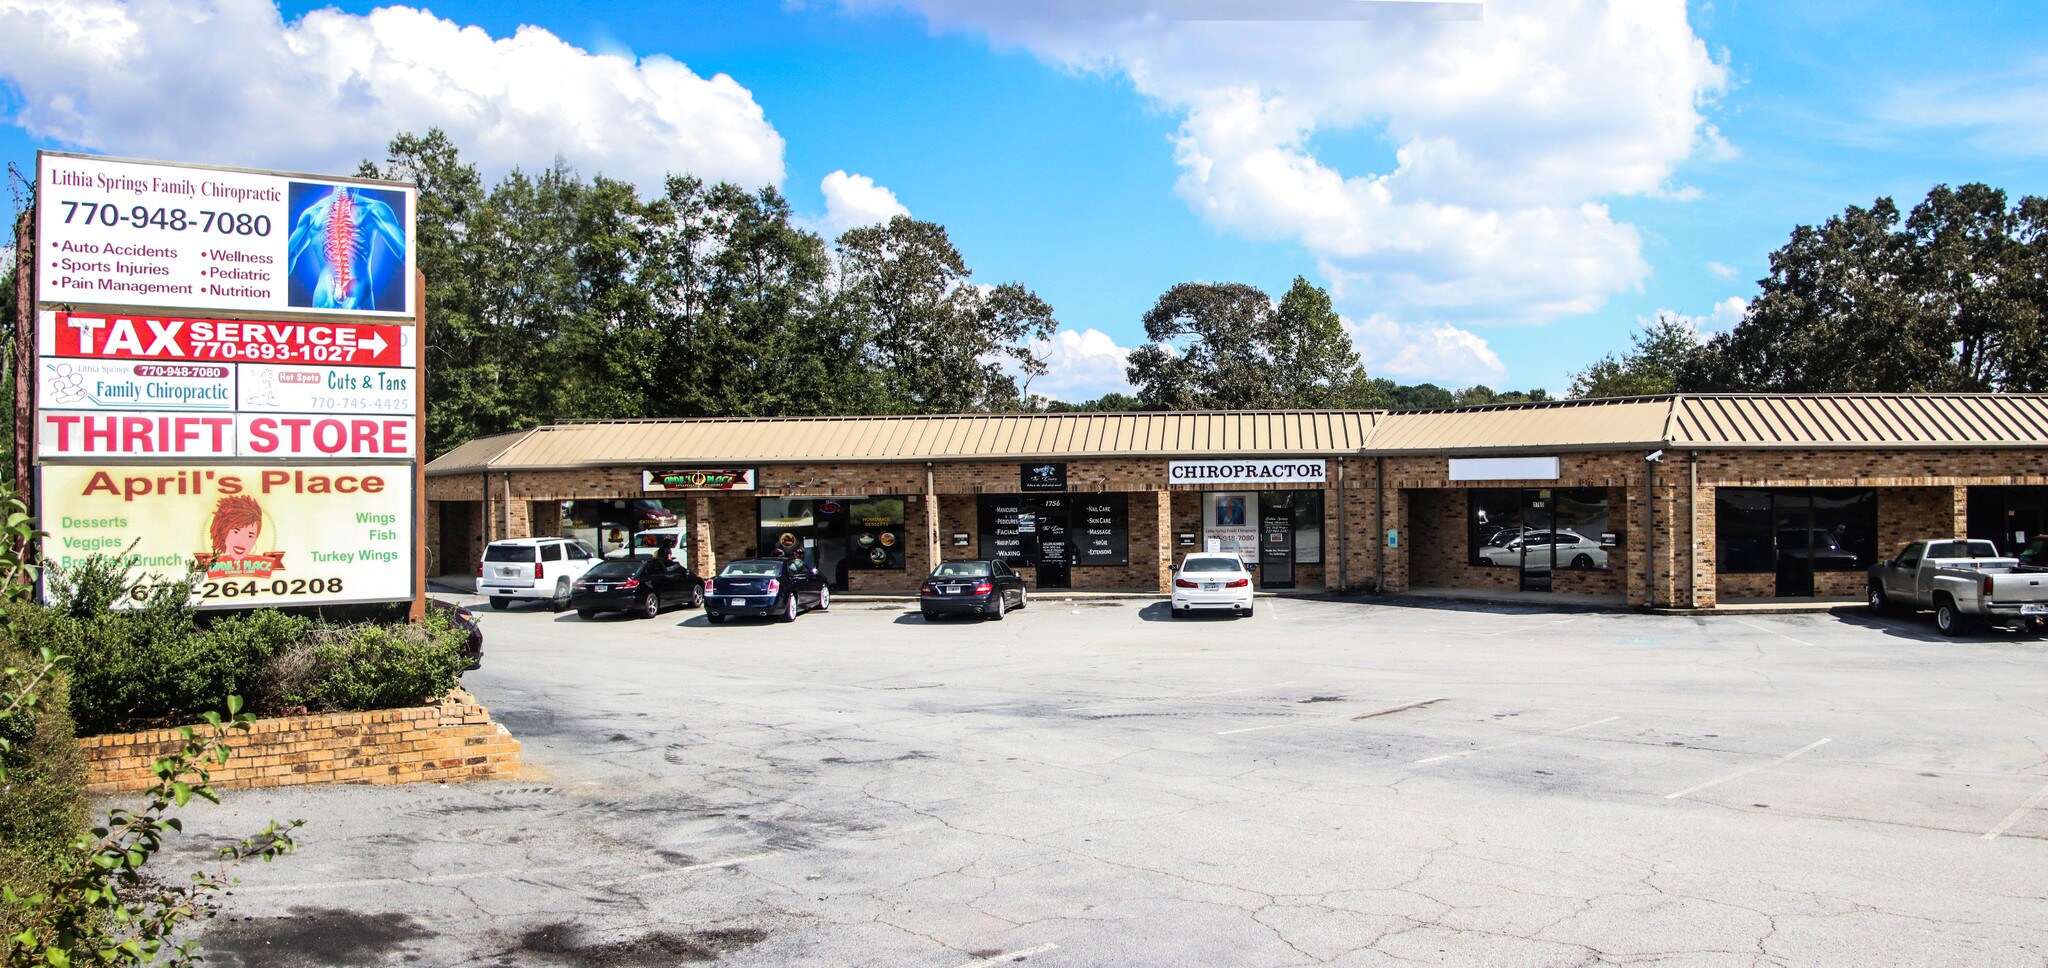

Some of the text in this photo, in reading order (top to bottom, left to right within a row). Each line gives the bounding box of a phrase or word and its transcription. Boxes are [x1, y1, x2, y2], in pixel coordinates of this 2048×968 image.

[51, 169, 281, 203] Lithia Springs Family Chiropractic
[62, 201, 271, 237] 770-948-7080
[62, 240, 178, 259] Auto Accidents
[210, 250, 273, 264] Wellness
[62, 258, 169, 276] Sports Injuries
[210, 267, 270, 281] Pediatric
[62, 276, 193, 295] Pain Management
[210, 284, 270, 299] Nutrition
[67, 318, 357, 357] TAX SERVICE
[190, 341, 357, 362] 770-693-1027
[78, 364, 129, 376] Lithia Springs
[142, 366, 221, 377] 770-948-7080
[279, 373, 319, 384] Hot Spots
[328, 371, 407, 391] Cuts & Tans
[97, 381, 229, 403] Family Chiropractic
[311, 397, 408, 410] 770-745-4425
[47, 416, 407, 453] THRIFT STORE
[1172, 464, 1323, 478] CHIROPRACTOR
[82, 470, 385, 501] April's Place
[707, 475, 733, 484] PLACE
[62, 515, 127, 528] Desserts
[356, 512, 396, 526] Wings
[369, 529, 396, 540] Fish
[63, 536, 122, 550] Veggies
[311, 550, 398, 564] Turkey Wings
[244, 560, 272, 571] PLACE
